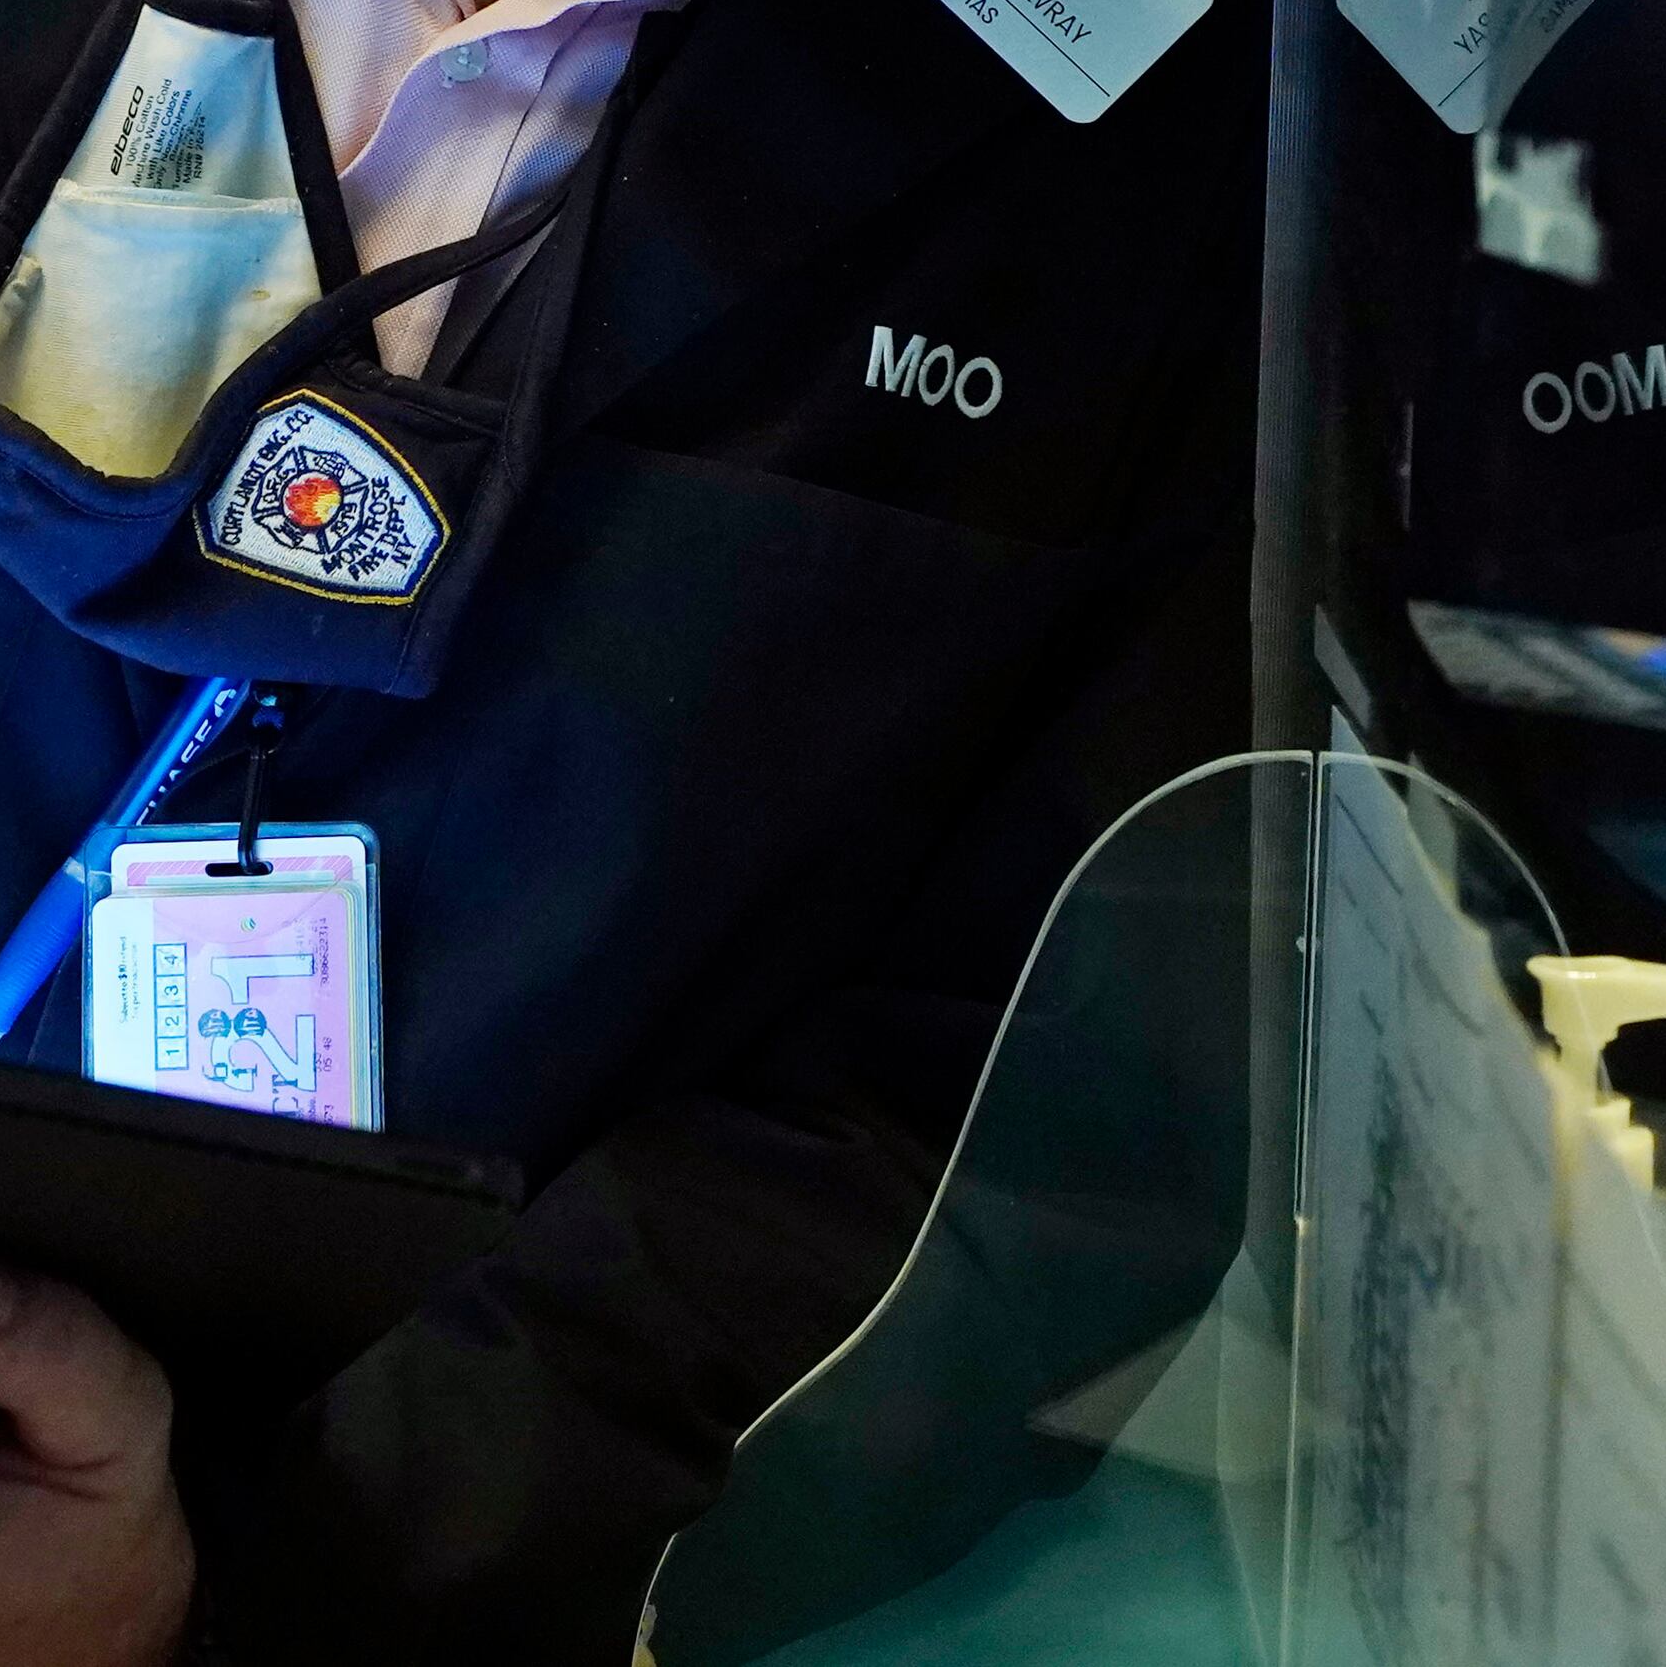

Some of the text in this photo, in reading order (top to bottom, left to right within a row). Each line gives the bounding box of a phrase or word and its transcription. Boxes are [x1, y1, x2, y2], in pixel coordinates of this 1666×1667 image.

[111, 85, 144, 176] elbeco
[126, 95, 154, 167] 100% Cotton
[145, 108, 161, 139] Wash
[156, 78, 172, 105] Cold
[147, 156, 159, 180] with
[161, 90, 180, 126] Colors
[865, 325, 1003, 419] MOO
[321, 476, 390, 574] MONTROSE
[348, 543, 389, 581] FIRE
[391, 533, 416, 569] NY
[164, 953, 180, 1057] 1 2 3 4
